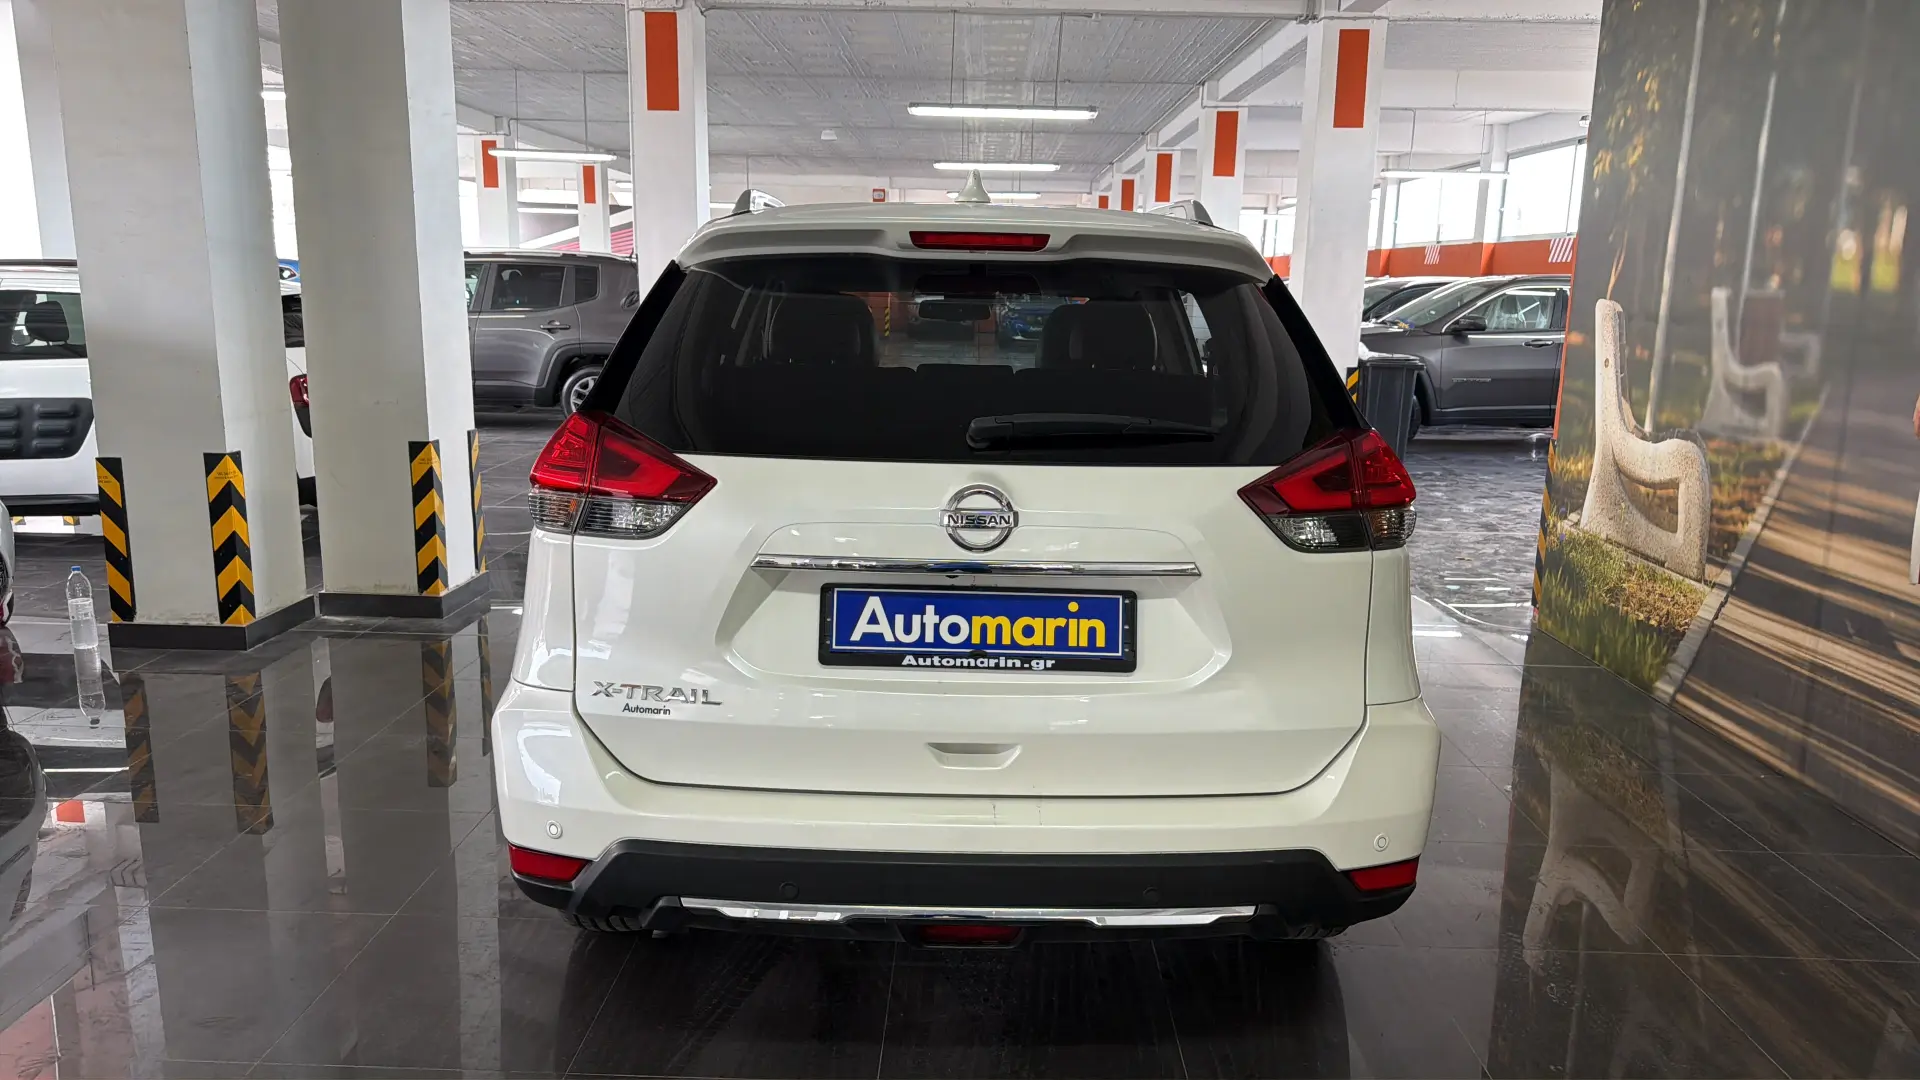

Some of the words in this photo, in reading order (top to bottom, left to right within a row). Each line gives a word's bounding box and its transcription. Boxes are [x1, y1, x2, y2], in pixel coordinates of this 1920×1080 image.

[947, 514, 1011, 526] NISSAN
[850, 595, 1106, 648] Automarin
[901, 655, 1056, 670] Automarin.gr
[591, 681, 723, 706] X-TRAIL
[622, 702, 671, 716] Automarin
